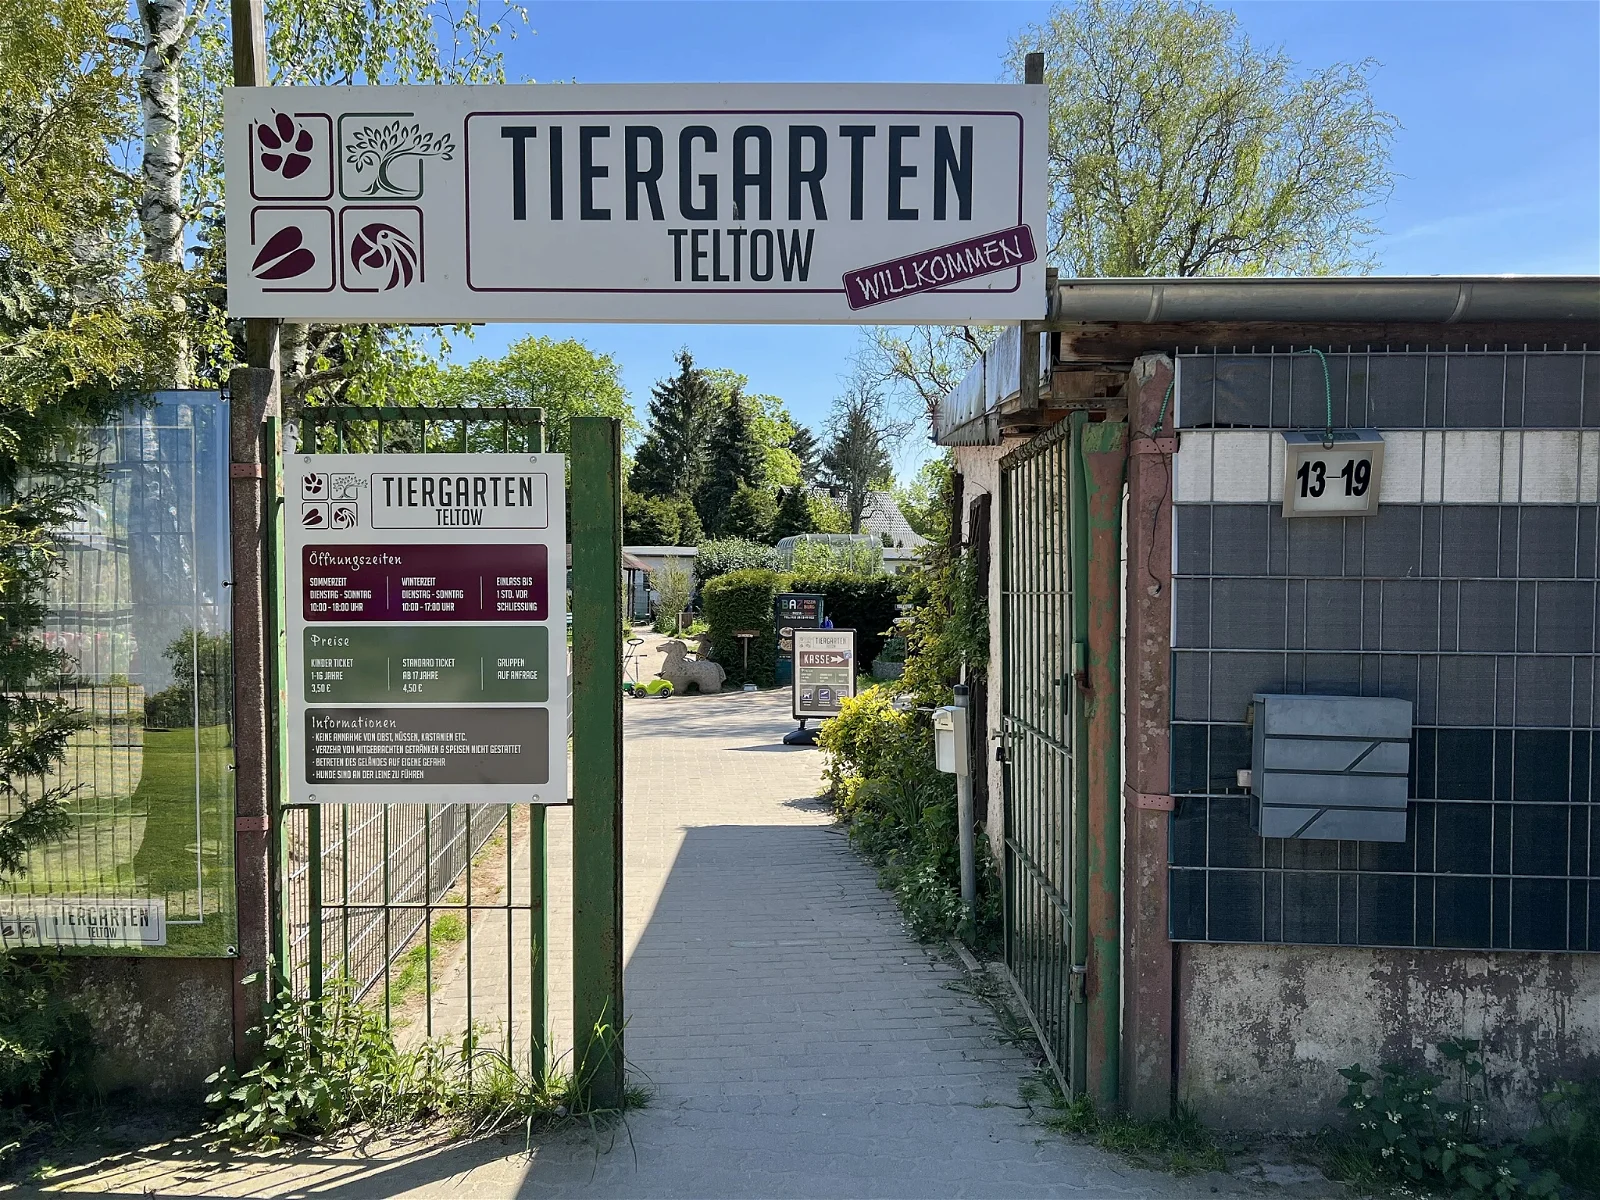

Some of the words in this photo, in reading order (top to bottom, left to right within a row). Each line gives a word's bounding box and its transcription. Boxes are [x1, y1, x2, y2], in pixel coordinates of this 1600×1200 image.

[500, 125, 974, 221] TIERGARTEN
[667, 228, 815, 282] TELTOW
[855, 234, 1023, 301] WILLKOMMEN
[382, 477, 533, 507] TIERGARTEN
[435, 508, 483, 526] TELTOW
[309, 550, 403, 572] Öffnungszeiten
[309, 577, 348, 587] SOMMERZEIT
[401, 577, 436, 587] WINTERZEIT
[496, 577, 521, 586] EINLASS
[522, 577, 533, 586] BIS
[309, 590, 339, 599] DIENSTAG
[343, 590, 372, 599] SONNTAG
[401, 590, 431, 599] DIENSTAG
[435, 590, 464, 599] SONNTAG
[501, 590, 514, 599] STD.
[516, 590, 528, 599] VOR
[310, 602, 327, 612] 10:00
[350, 602, 364, 612] UHR
[401, 602, 419, 612] 10:00
[424, 602, 441, 612] 17:00
[441, 602, 455, 612] UHR
[496, 602, 538, 612] SCHLIESSUNG
[310, 634, 350, 647] Preise
[815, 637, 847, 645] TIERGARTEN
[310, 658, 332, 668] KINDER
[333, 658, 354, 668] TICKET
[402, 658, 434, 667] STANDARD
[435, 658, 455, 667] TICKET
[497, 658, 525, 667] GRUPPEN
[803, 654, 830, 664] KASSE
[324, 671, 343, 680] JAHRE
[402, 671, 412, 680] AB
[412, 671, 419, 680] 17
[419, 671, 439, 680] JAHRE
[497, 671, 510, 680] AUF
[510, 671, 538, 680] ANFRAGE
[311, 683, 325, 693] 3,50
[402, 683, 417, 693] 4,50
[312, 715, 397, 730] Informationen
[315, 732, 332, 742] KEINE
[333, 732, 362, 742] ANNAHME
[363, 732, 376, 742] VON
[376, 732, 394, 743] OBST,
[394, 731, 420, 743] NÜSSEN,
[421, 732, 454, 742] KASTANIEN
[455, 732, 468, 742] ETC.
[315, 745, 341, 754] VERZEHR
[342, 745, 355, 754] VON
[356, 745, 404, 754] MITGEBRACHTEN
[405, 744, 439, 754] GETRÄNKEN
[445, 745, 470, 754] SPEISEN
[471, 745, 489, 754] NICHT
[489, 745, 522, 754] GESTATTET
[315, 757, 344, 767] BETRETEN
[345, 757, 357, 767] DES
[357, 756, 388, 767] GELÄNDES
[388, 757, 400, 767] AUF
[401, 757, 422, 767] EIGENE
[422, 757, 446, 767] GEFAHR
[315, 770, 336, 779] HUNDE
[337, 770, 352, 779] SIND
[352, 770, 361, 779] AN
[362, 770, 374, 779] DER
[375, 770, 391, 779] LEINE
[391, 770, 400, 779] ZU
[400, 769, 424, 779] FÜHREN
[53, 906, 150, 927] TIERGARTEN
[87, 926, 118, 938] TELTOW
